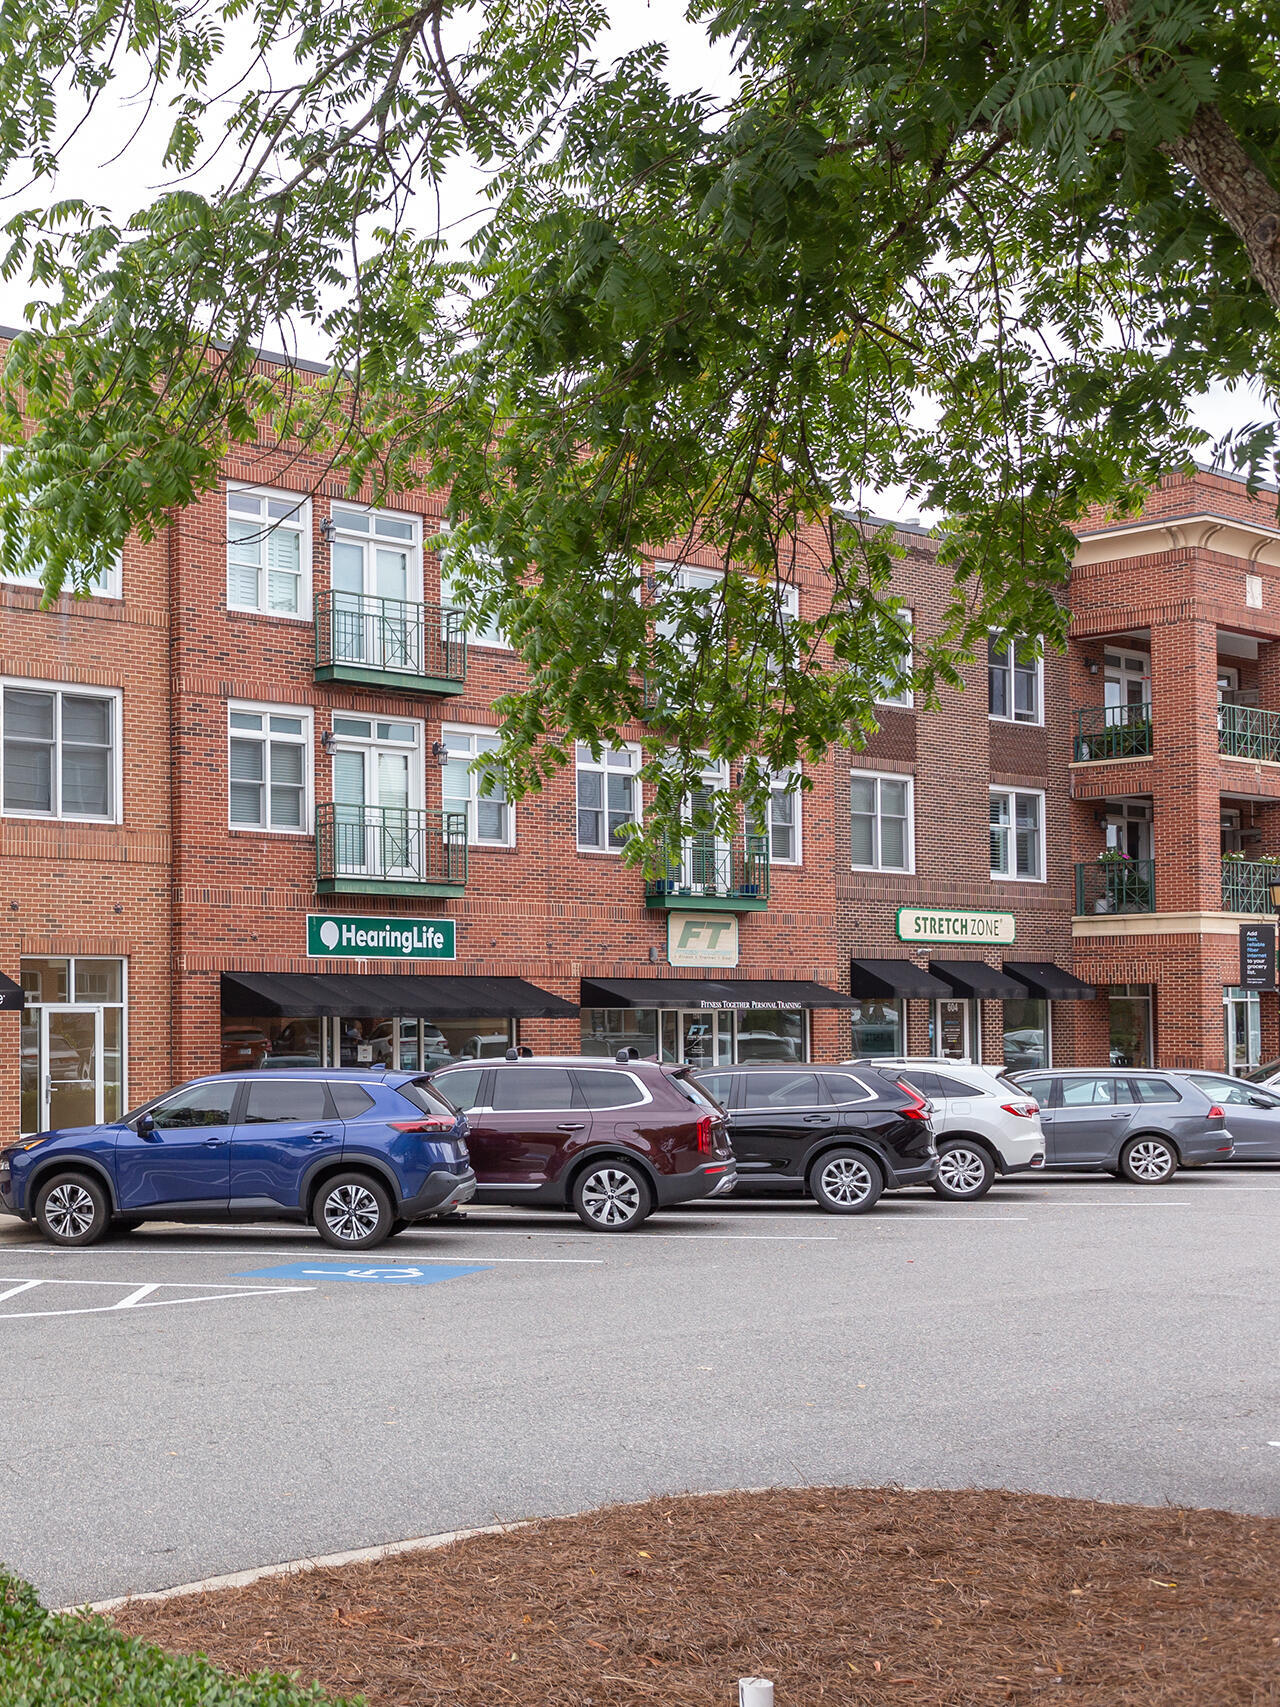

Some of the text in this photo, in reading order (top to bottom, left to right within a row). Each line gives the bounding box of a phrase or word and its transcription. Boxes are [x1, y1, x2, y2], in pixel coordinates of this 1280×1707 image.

[914, 916, 1000, 936] STRETCH ZONE
[341, 924, 445, 954] HearingLife
[677, 920, 732, 949] FT
[701, 1000, 802, 1009] FITNESS TOGETHER PERSONAL TRAINING
[947, 1003, 958, 1012] 604
[688, 1024, 709, 1035] FT
